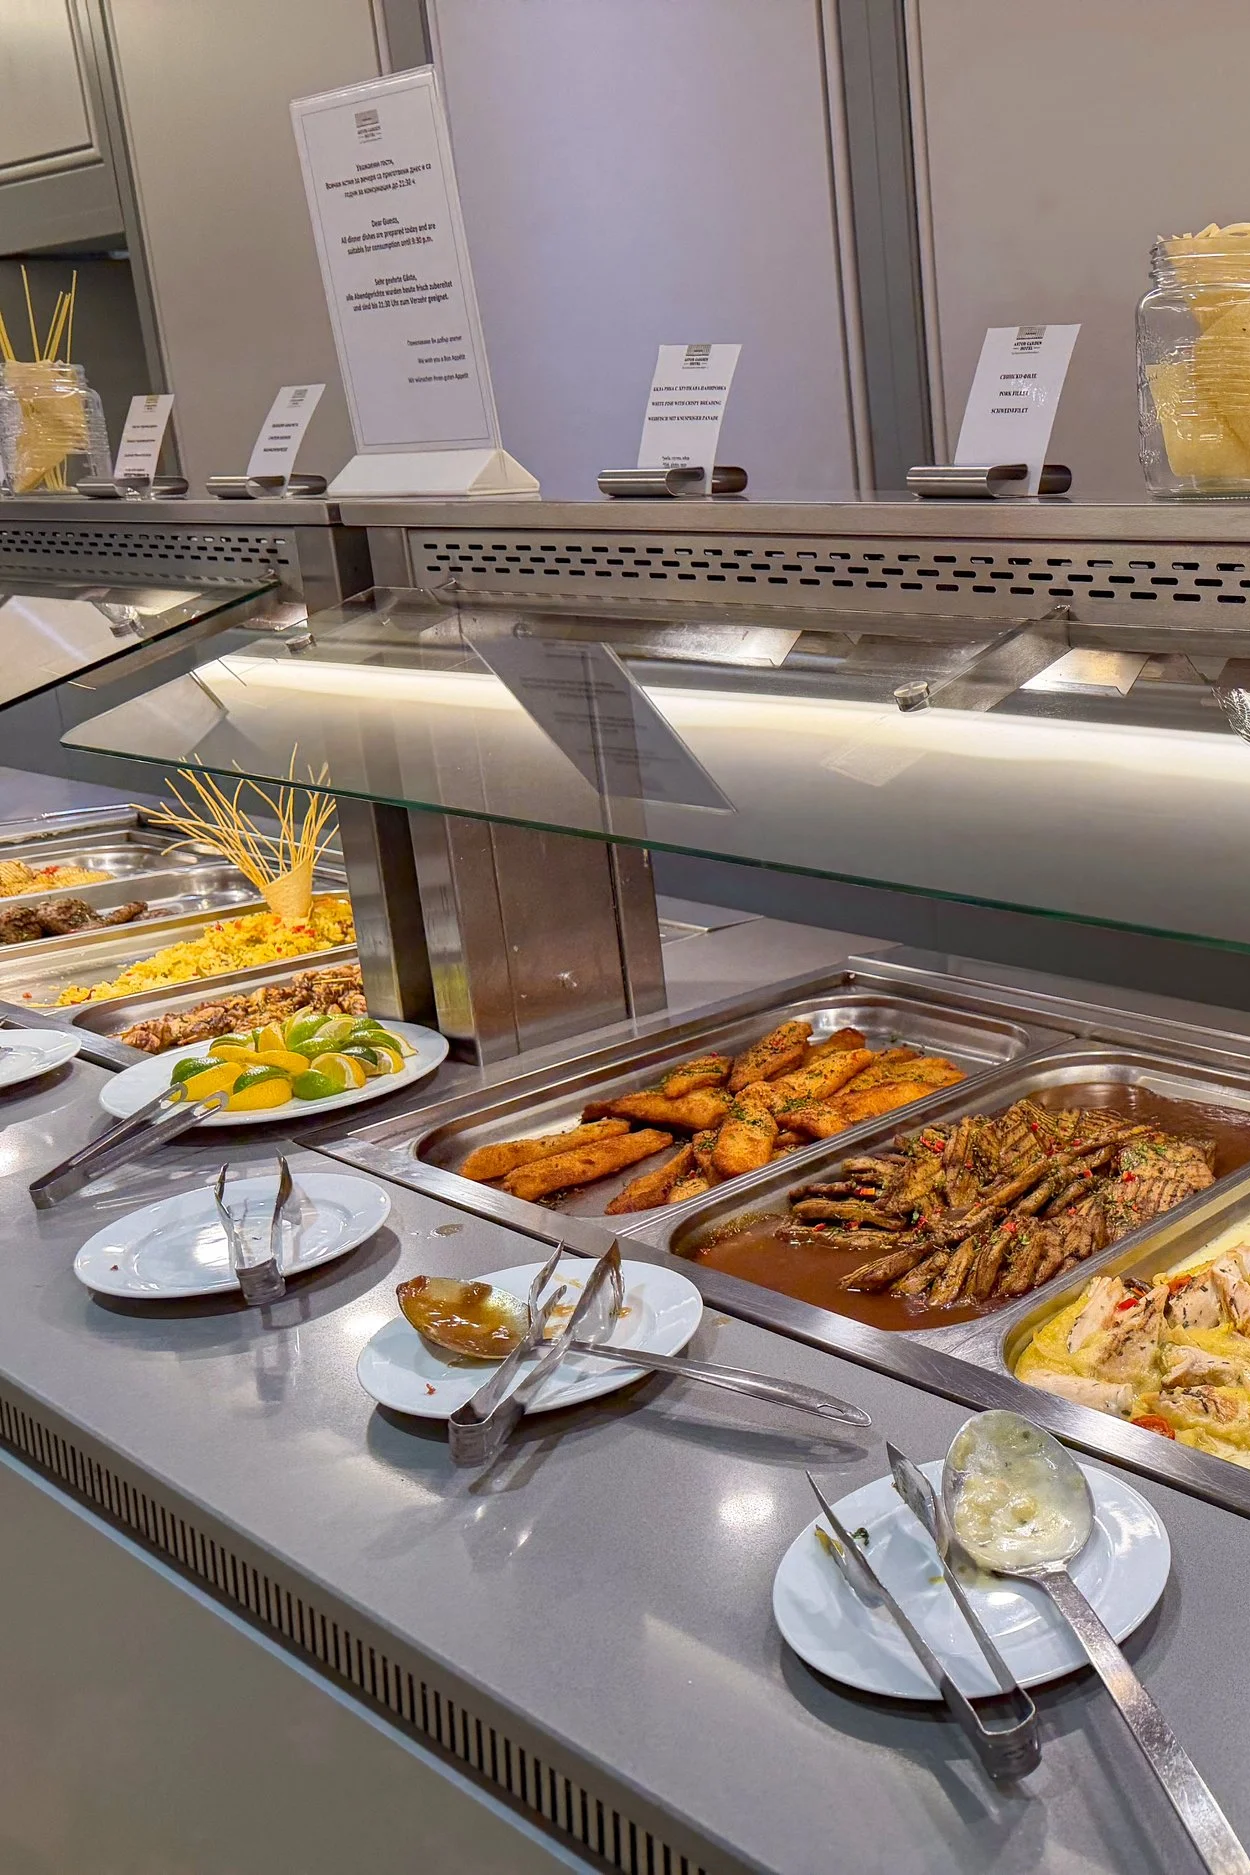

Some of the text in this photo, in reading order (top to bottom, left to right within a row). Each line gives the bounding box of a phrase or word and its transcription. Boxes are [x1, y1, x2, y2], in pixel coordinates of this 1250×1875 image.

[371, 217, 400, 228] Dear Guests,
[347, 234, 361, 244] dinner
[361, 232, 376, 241] dishes
[384, 226, 405, 239] prepared
[404, 225, 418, 235] today
[418, 222, 428, 232] and
[347, 244, 365, 255] suitable
[364, 243, 372, 252] for
[372, 239, 400, 251] consumption
[400, 237, 412, 247] until
[374, 278, 385, 286] Sehr
[385, 276, 402, 286] geehrte
[346, 293, 354, 301] alle
[354, 289, 386, 301] Abendgerichte
[402, 285, 416, 294] heute
[415, 283, 429, 292] frisch
[429, 280, 453, 291] zubereitet
[353, 303, 362, 312] und
[362, 302, 371, 311] sind
[371, 301, 379, 310] bis
[391, 298, 400, 307] Uhr
[410, 295, 428, 305] Verzehr
